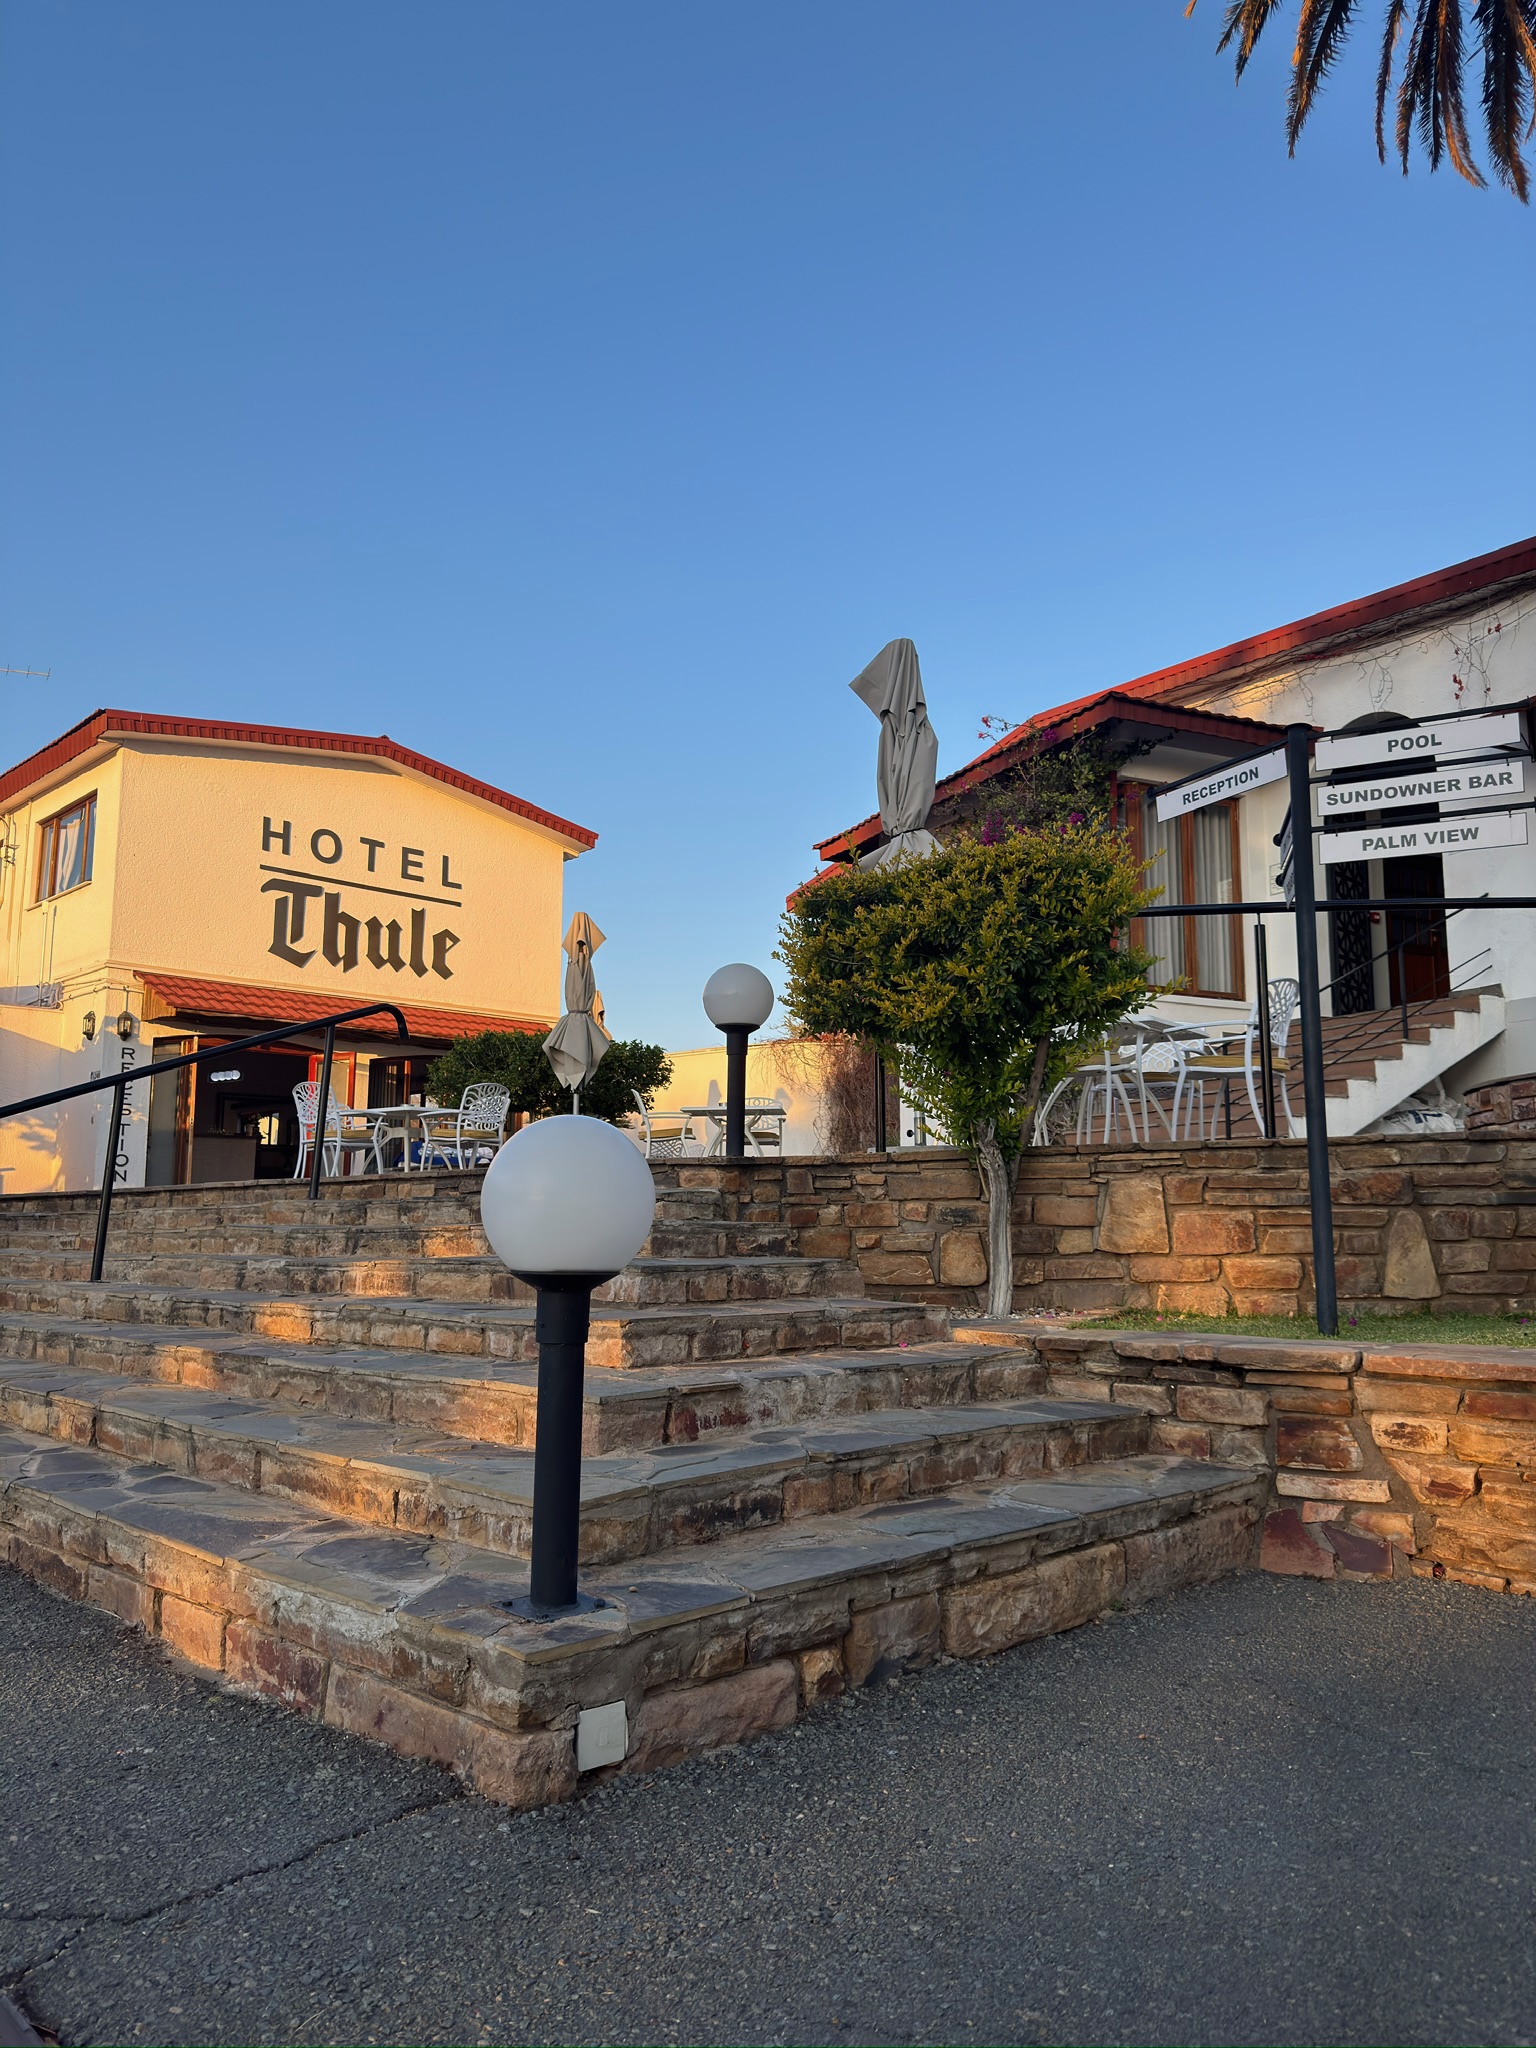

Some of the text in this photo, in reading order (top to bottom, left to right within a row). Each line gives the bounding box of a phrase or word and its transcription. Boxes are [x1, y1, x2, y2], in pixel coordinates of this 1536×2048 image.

[1387, 733, 1442, 753] POOL
[1182, 766, 1259, 805] RECEPTION
[1326, 771, 1514, 806] SUNDOWNER BAR
[262, 816, 462, 890] HOTEL
[1362, 826, 1479, 852] PALM VIEW
[260, 877, 461, 980] Thule
